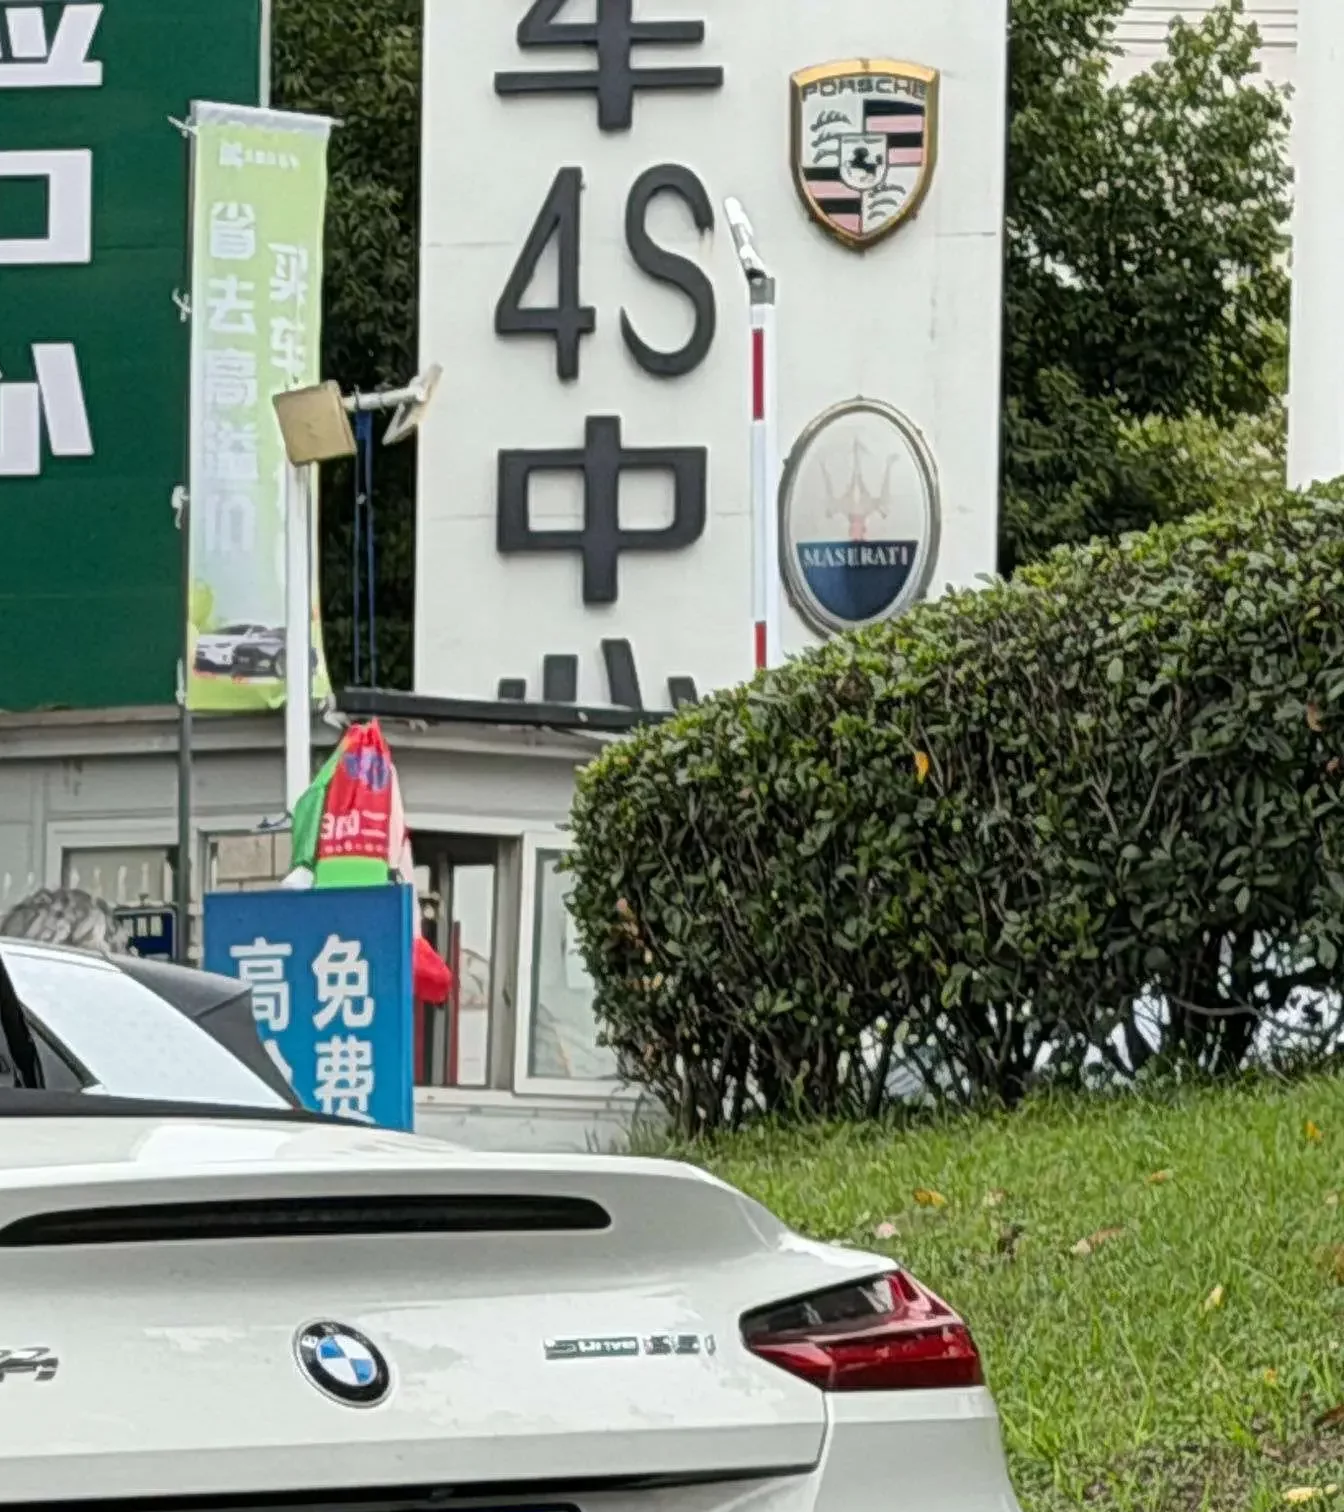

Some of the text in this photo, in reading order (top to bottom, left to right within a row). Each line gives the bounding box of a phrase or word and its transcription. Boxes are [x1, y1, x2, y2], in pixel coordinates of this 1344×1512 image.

[801, 77, 927, 102] PORSCHE
[803, 546, 909, 568] MASERATI
[311, 933, 376, 1124] 免费
